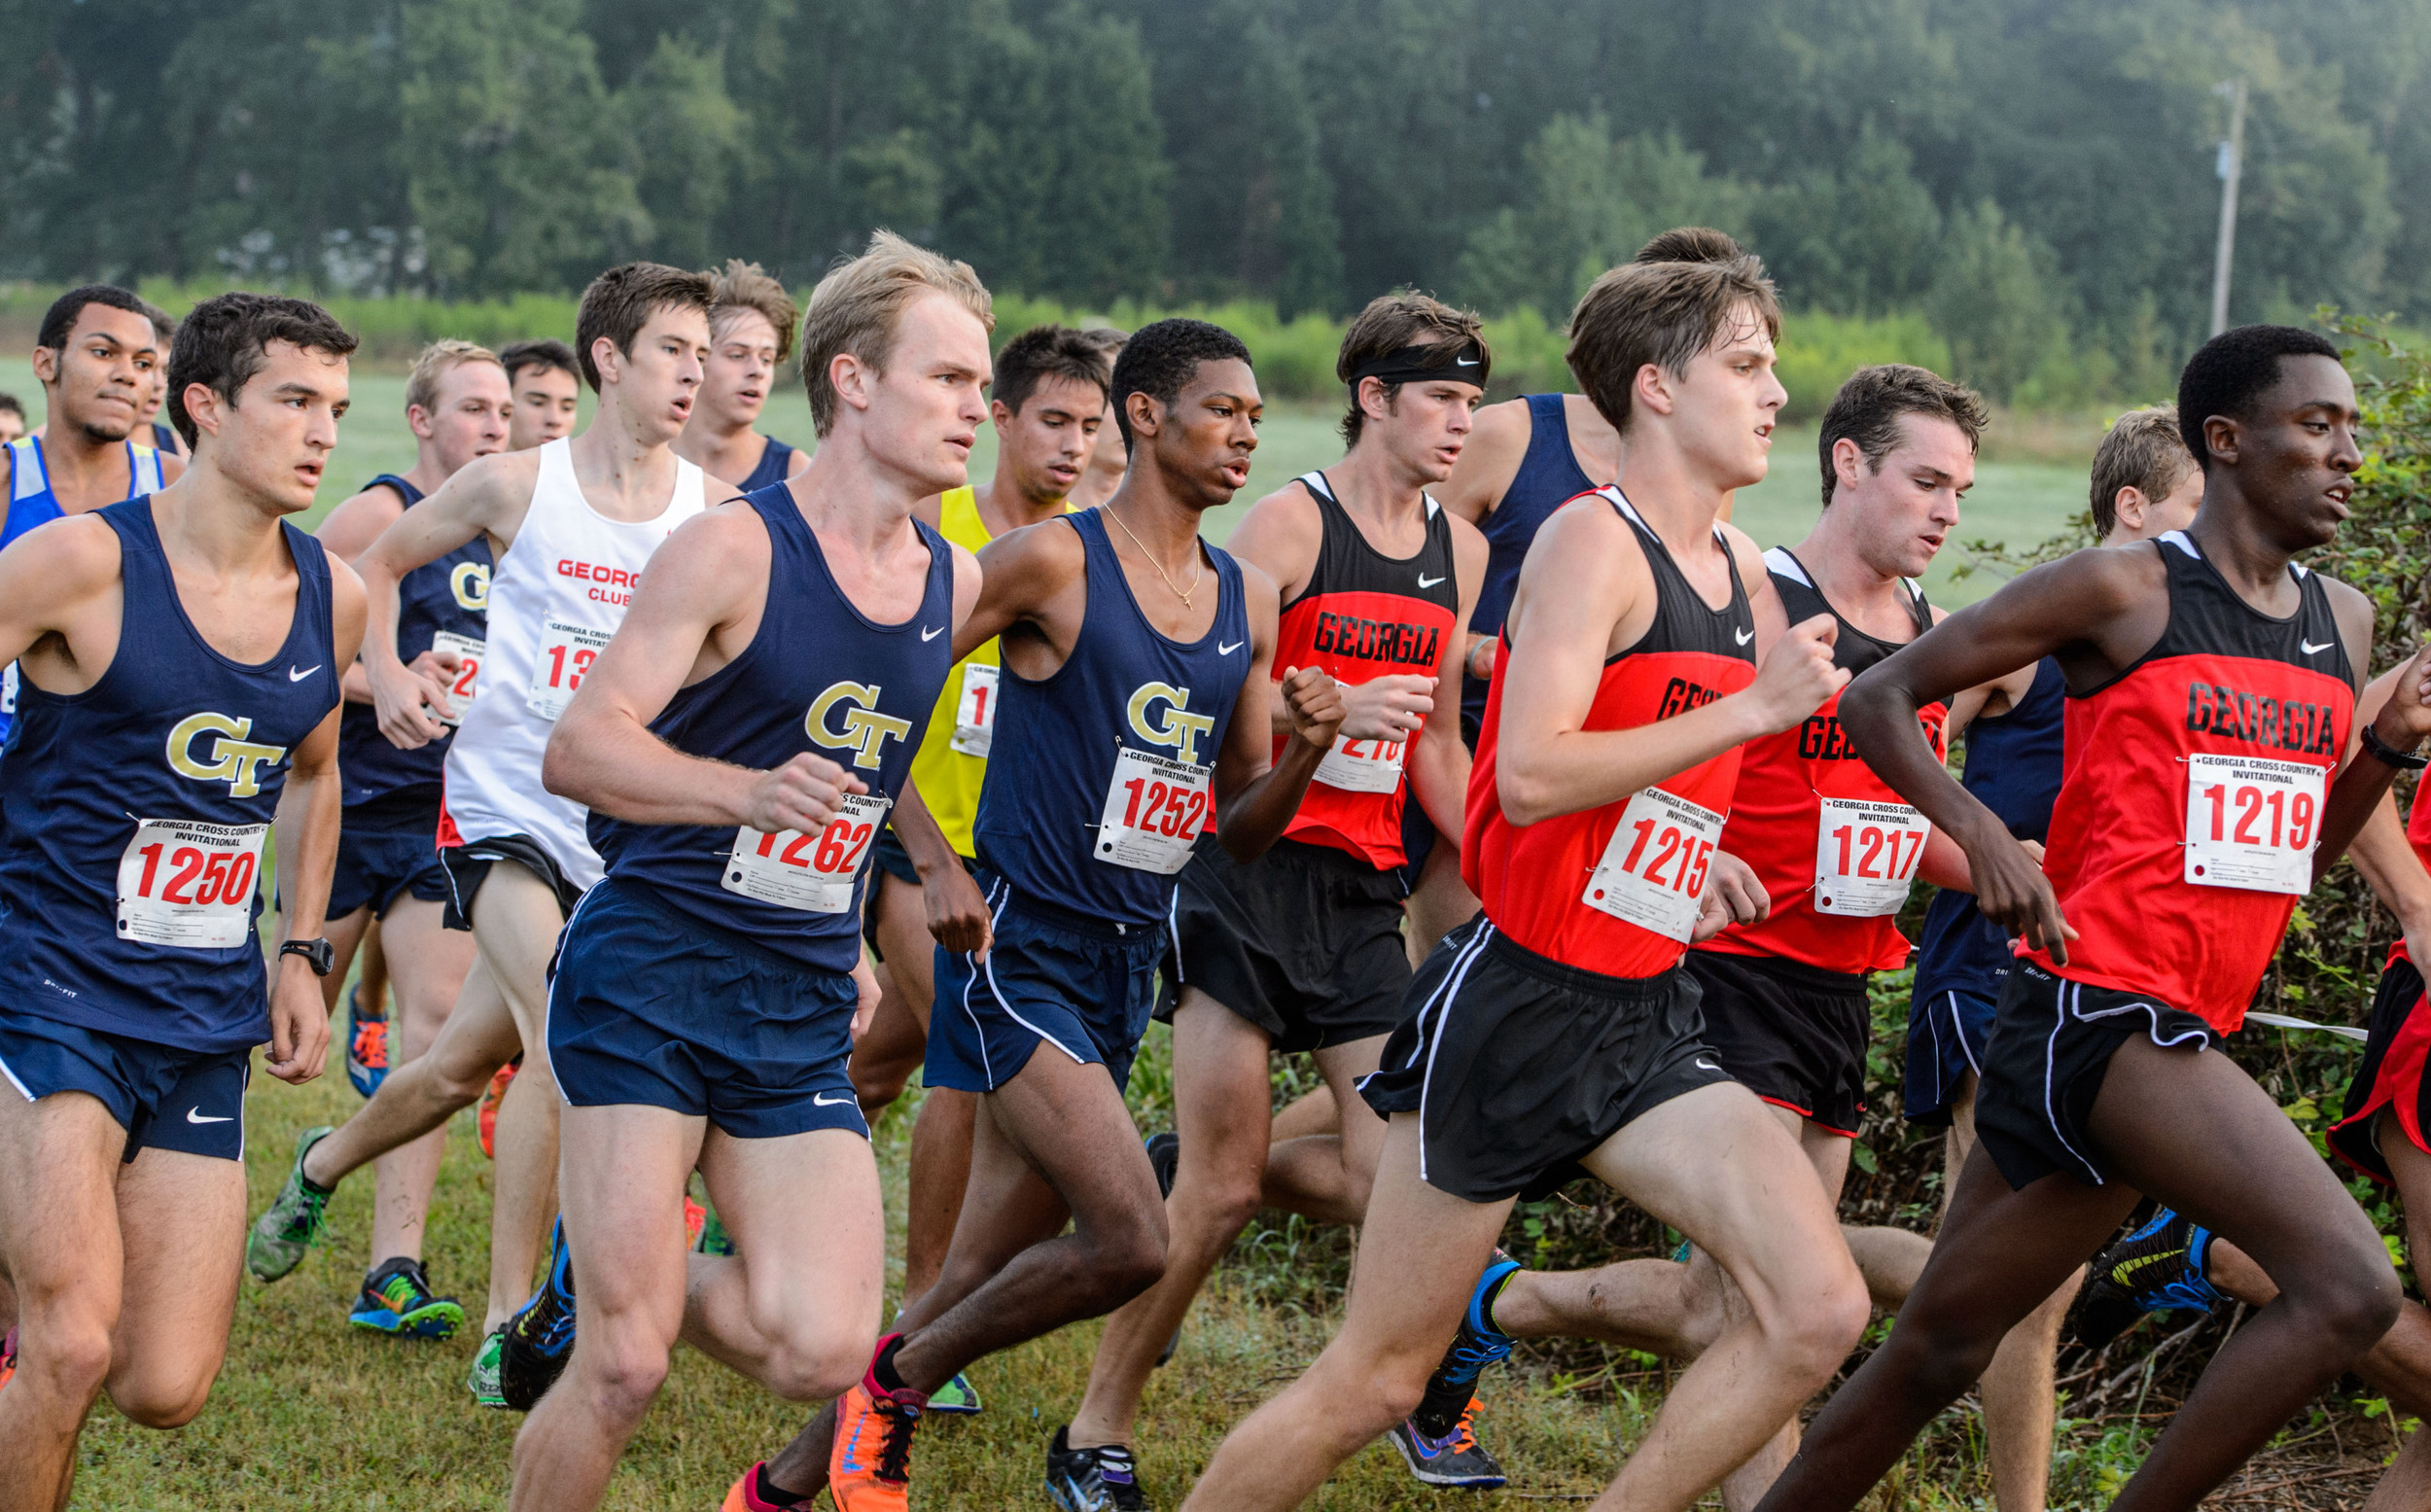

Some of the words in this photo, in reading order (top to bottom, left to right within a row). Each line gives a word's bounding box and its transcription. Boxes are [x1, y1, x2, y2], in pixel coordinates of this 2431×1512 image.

[557, 559, 641, 589] GEOR
[551, 622, 587, 636] GEORGIA
[590, 629, 615, 641] CROS
[574, 636, 608, 649] INVITAT
[1314, 611, 1439, 667] GEORGIA
[2187, 682, 2334, 756] GEORGIA
[1130, 752, 1164, 766] GEORGIA
[1164, 760, 1188, 773] CROSS
[1188, 764, 1210, 777] COUNT
[1151, 767, 1196, 785] INVITATIONAL
[2202, 756, 2246, 768] GEORGIA
[2249, 759, 2279, 772] CROSS
[2280, 763, 2317, 777] COUNTRY
[2232, 770, 2294, 785] INVITATIONAL
[1122, 777, 1207, 841] 1252
[1645, 788, 1680, 808] GEORGIA
[1681, 802, 1701, 817] CROSS
[1832, 799, 1871, 811] GEORGIA
[1872, 803, 1899, 814] CROSS
[150, 821, 194, 831] GEORGIA
[195, 824, 229, 836] CROSS
[229, 826, 261, 837] COUNTRY
[1666, 809, 1706, 832] INVITATIONAL
[1858, 812, 1910, 826] INVITATIONAL
[2203, 783, 2314, 852] 1219
[174, 831, 241, 847] INVITATIONAL
[1621, 818, 1714, 899] 1215
[1832, 825, 1924, 880] 1217
[137, 842, 256, 906] 1250
